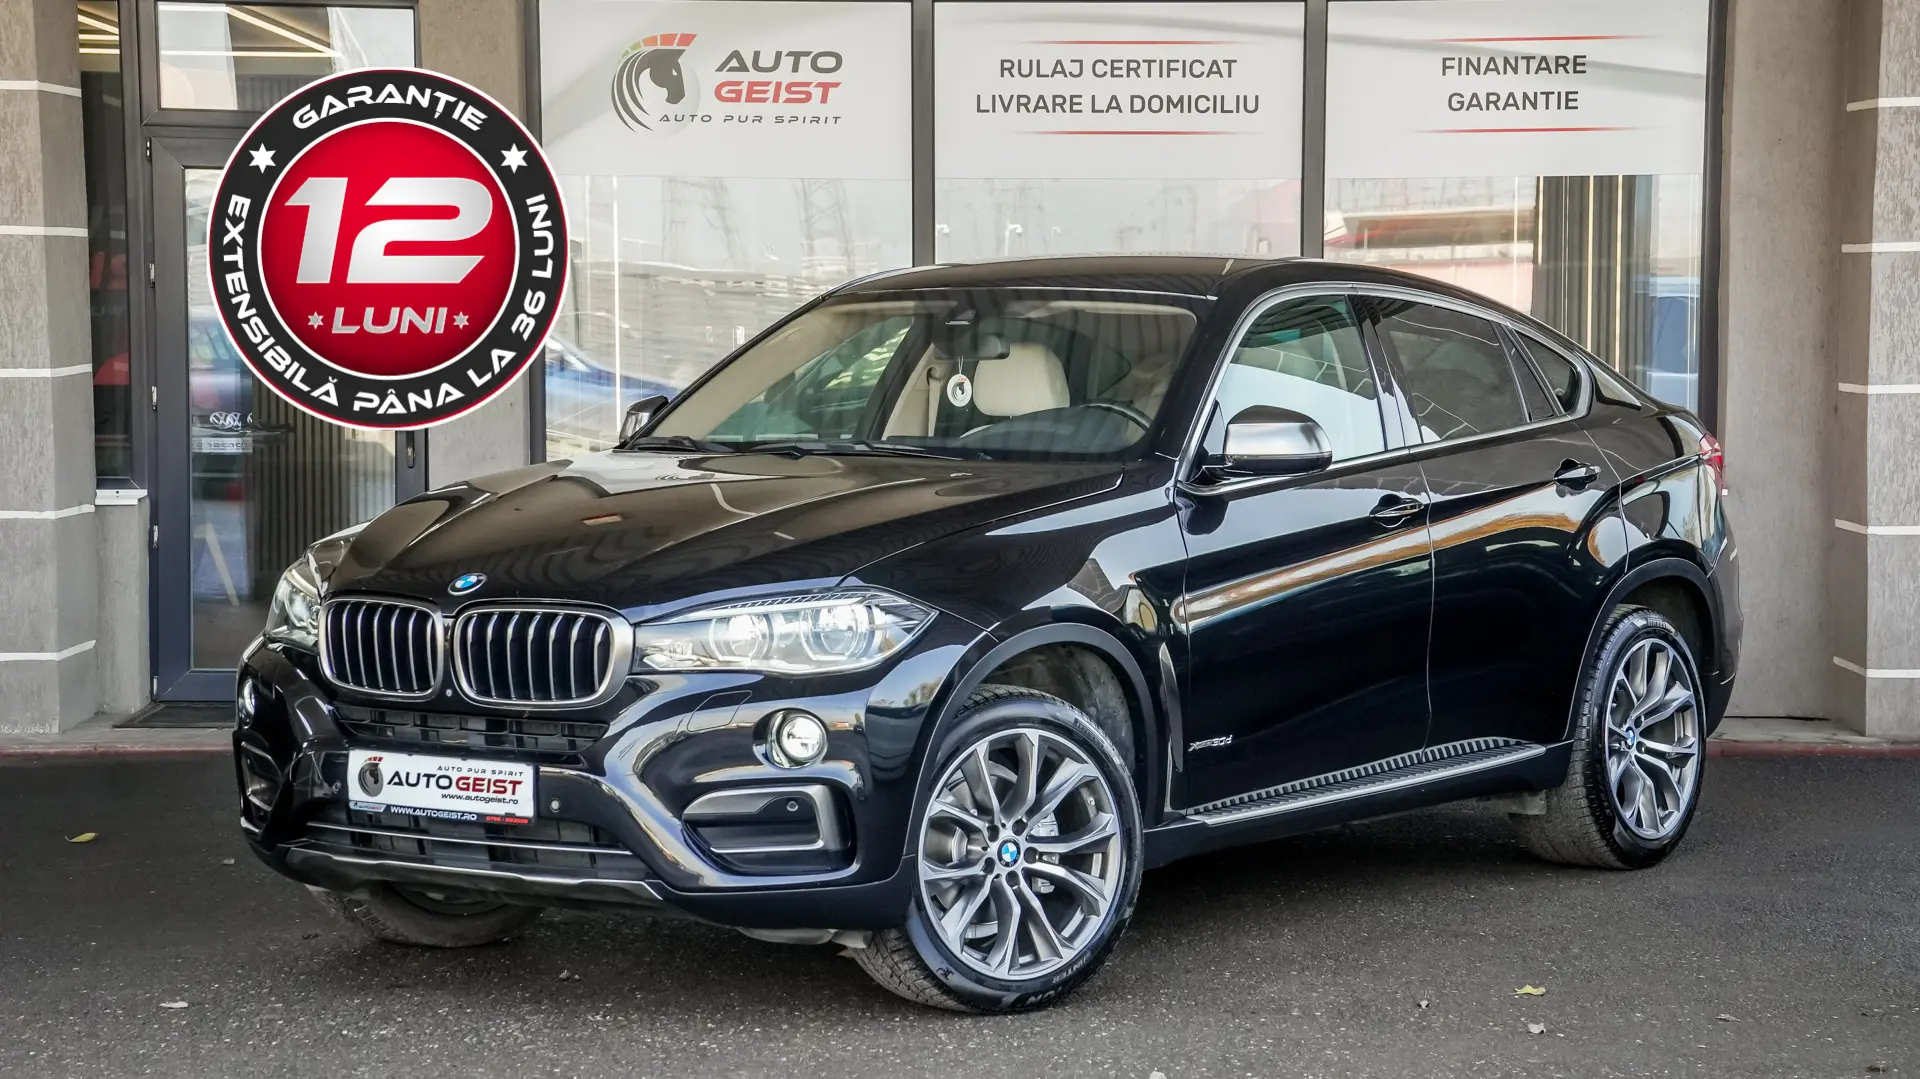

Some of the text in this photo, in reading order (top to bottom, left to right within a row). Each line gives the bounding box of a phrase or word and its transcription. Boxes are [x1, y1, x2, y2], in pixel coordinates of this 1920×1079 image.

[714, 49, 843, 74] AUTO
[1000, 58, 1238, 79] RULAJ CERTIFICAT
[1441, 54, 1587, 77] FINANTARE
[714, 80, 842, 104] GEIST
[1447, 90, 1579, 112] GARANTIE
[976, 94, 1260, 114] LIVRARE LA DOMICILIU
[659, 113, 842, 125] AUTO PUR SPIRIT
[437, 765, 524, 777] AUTO PUR SPIRIT
[441, 793, 519, 804] www.autogeist.ro
[390, 805, 478, 820] WWW.AUTOGEIST.RO
